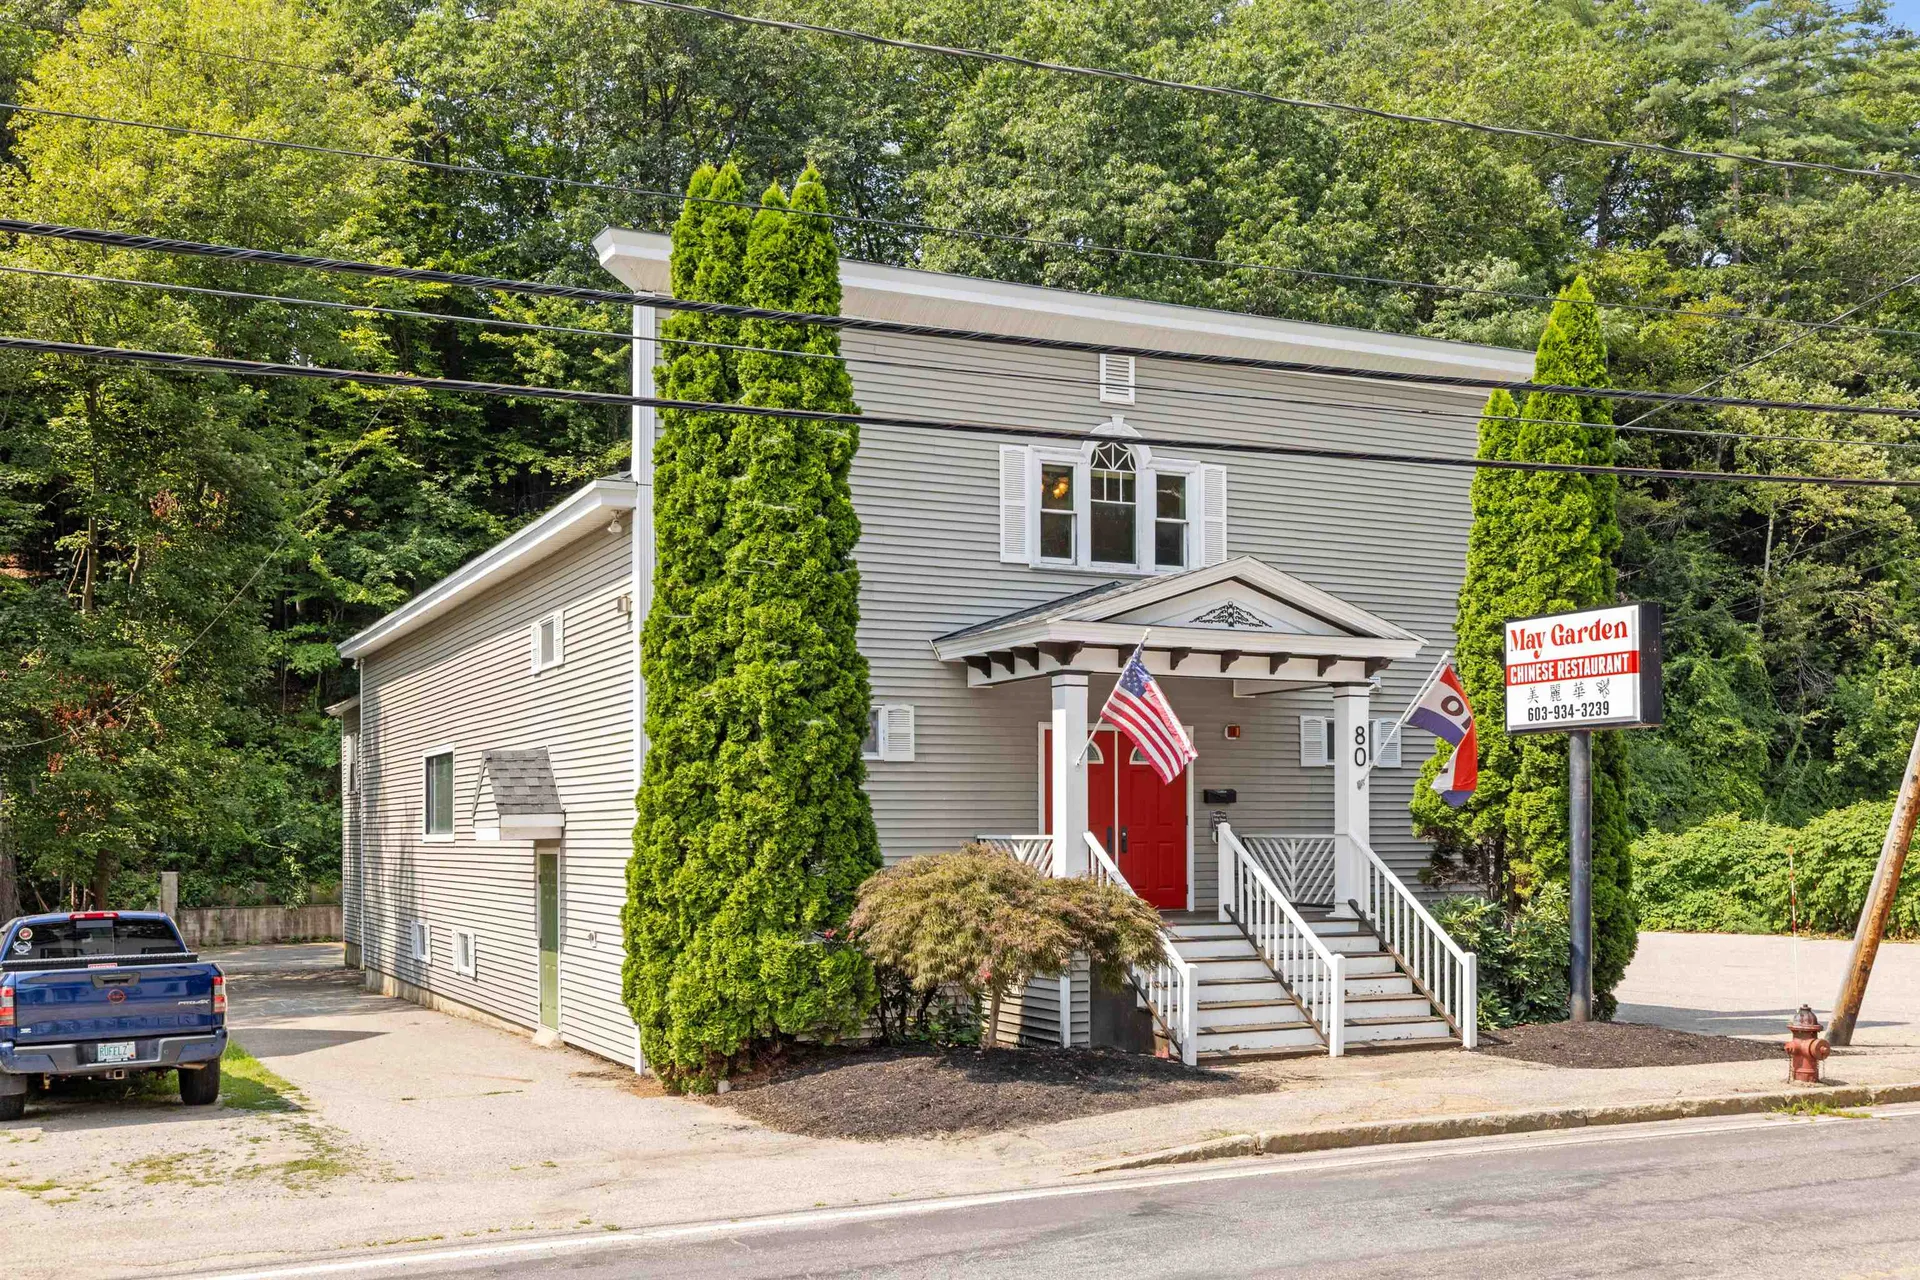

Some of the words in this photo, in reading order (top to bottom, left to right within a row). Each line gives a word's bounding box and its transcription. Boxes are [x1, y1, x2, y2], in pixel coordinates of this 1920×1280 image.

[1510, 628, 1546, 660] May
[1551, 618, 1629, 647] Garden
[1510, 661, 1555, 684] CHINESE
[1557, 653, 1630, 680] RESTAURANT
[1527, 700, 1610, 722] 603-934-3239
